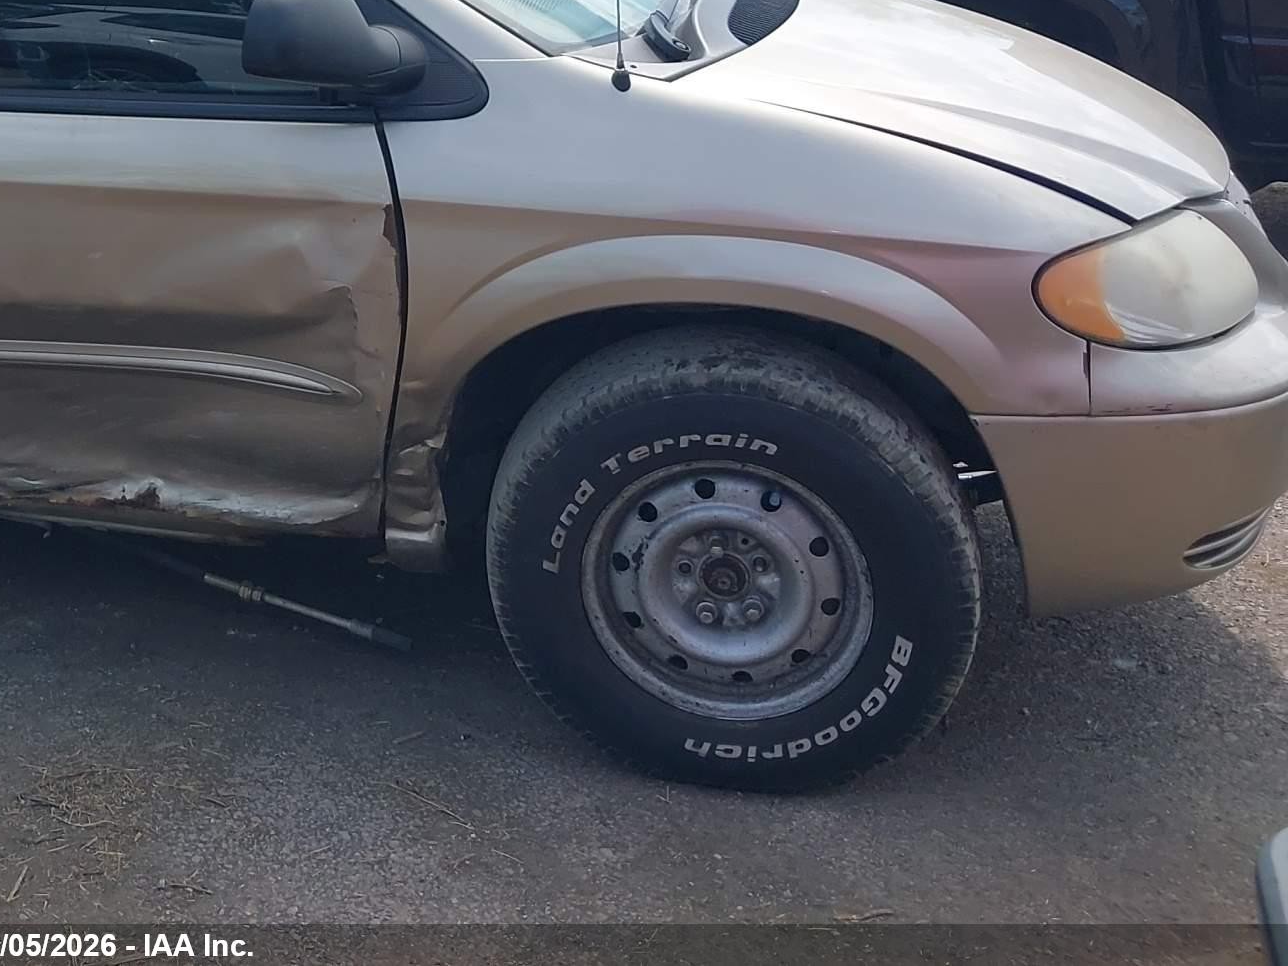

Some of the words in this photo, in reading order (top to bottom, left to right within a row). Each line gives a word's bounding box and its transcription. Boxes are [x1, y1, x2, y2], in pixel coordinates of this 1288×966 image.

[542, 480, 596, 574] Land
[599, 433, 779, 474] Terrain
[684, 634, 914, 763] BFGoodrich
